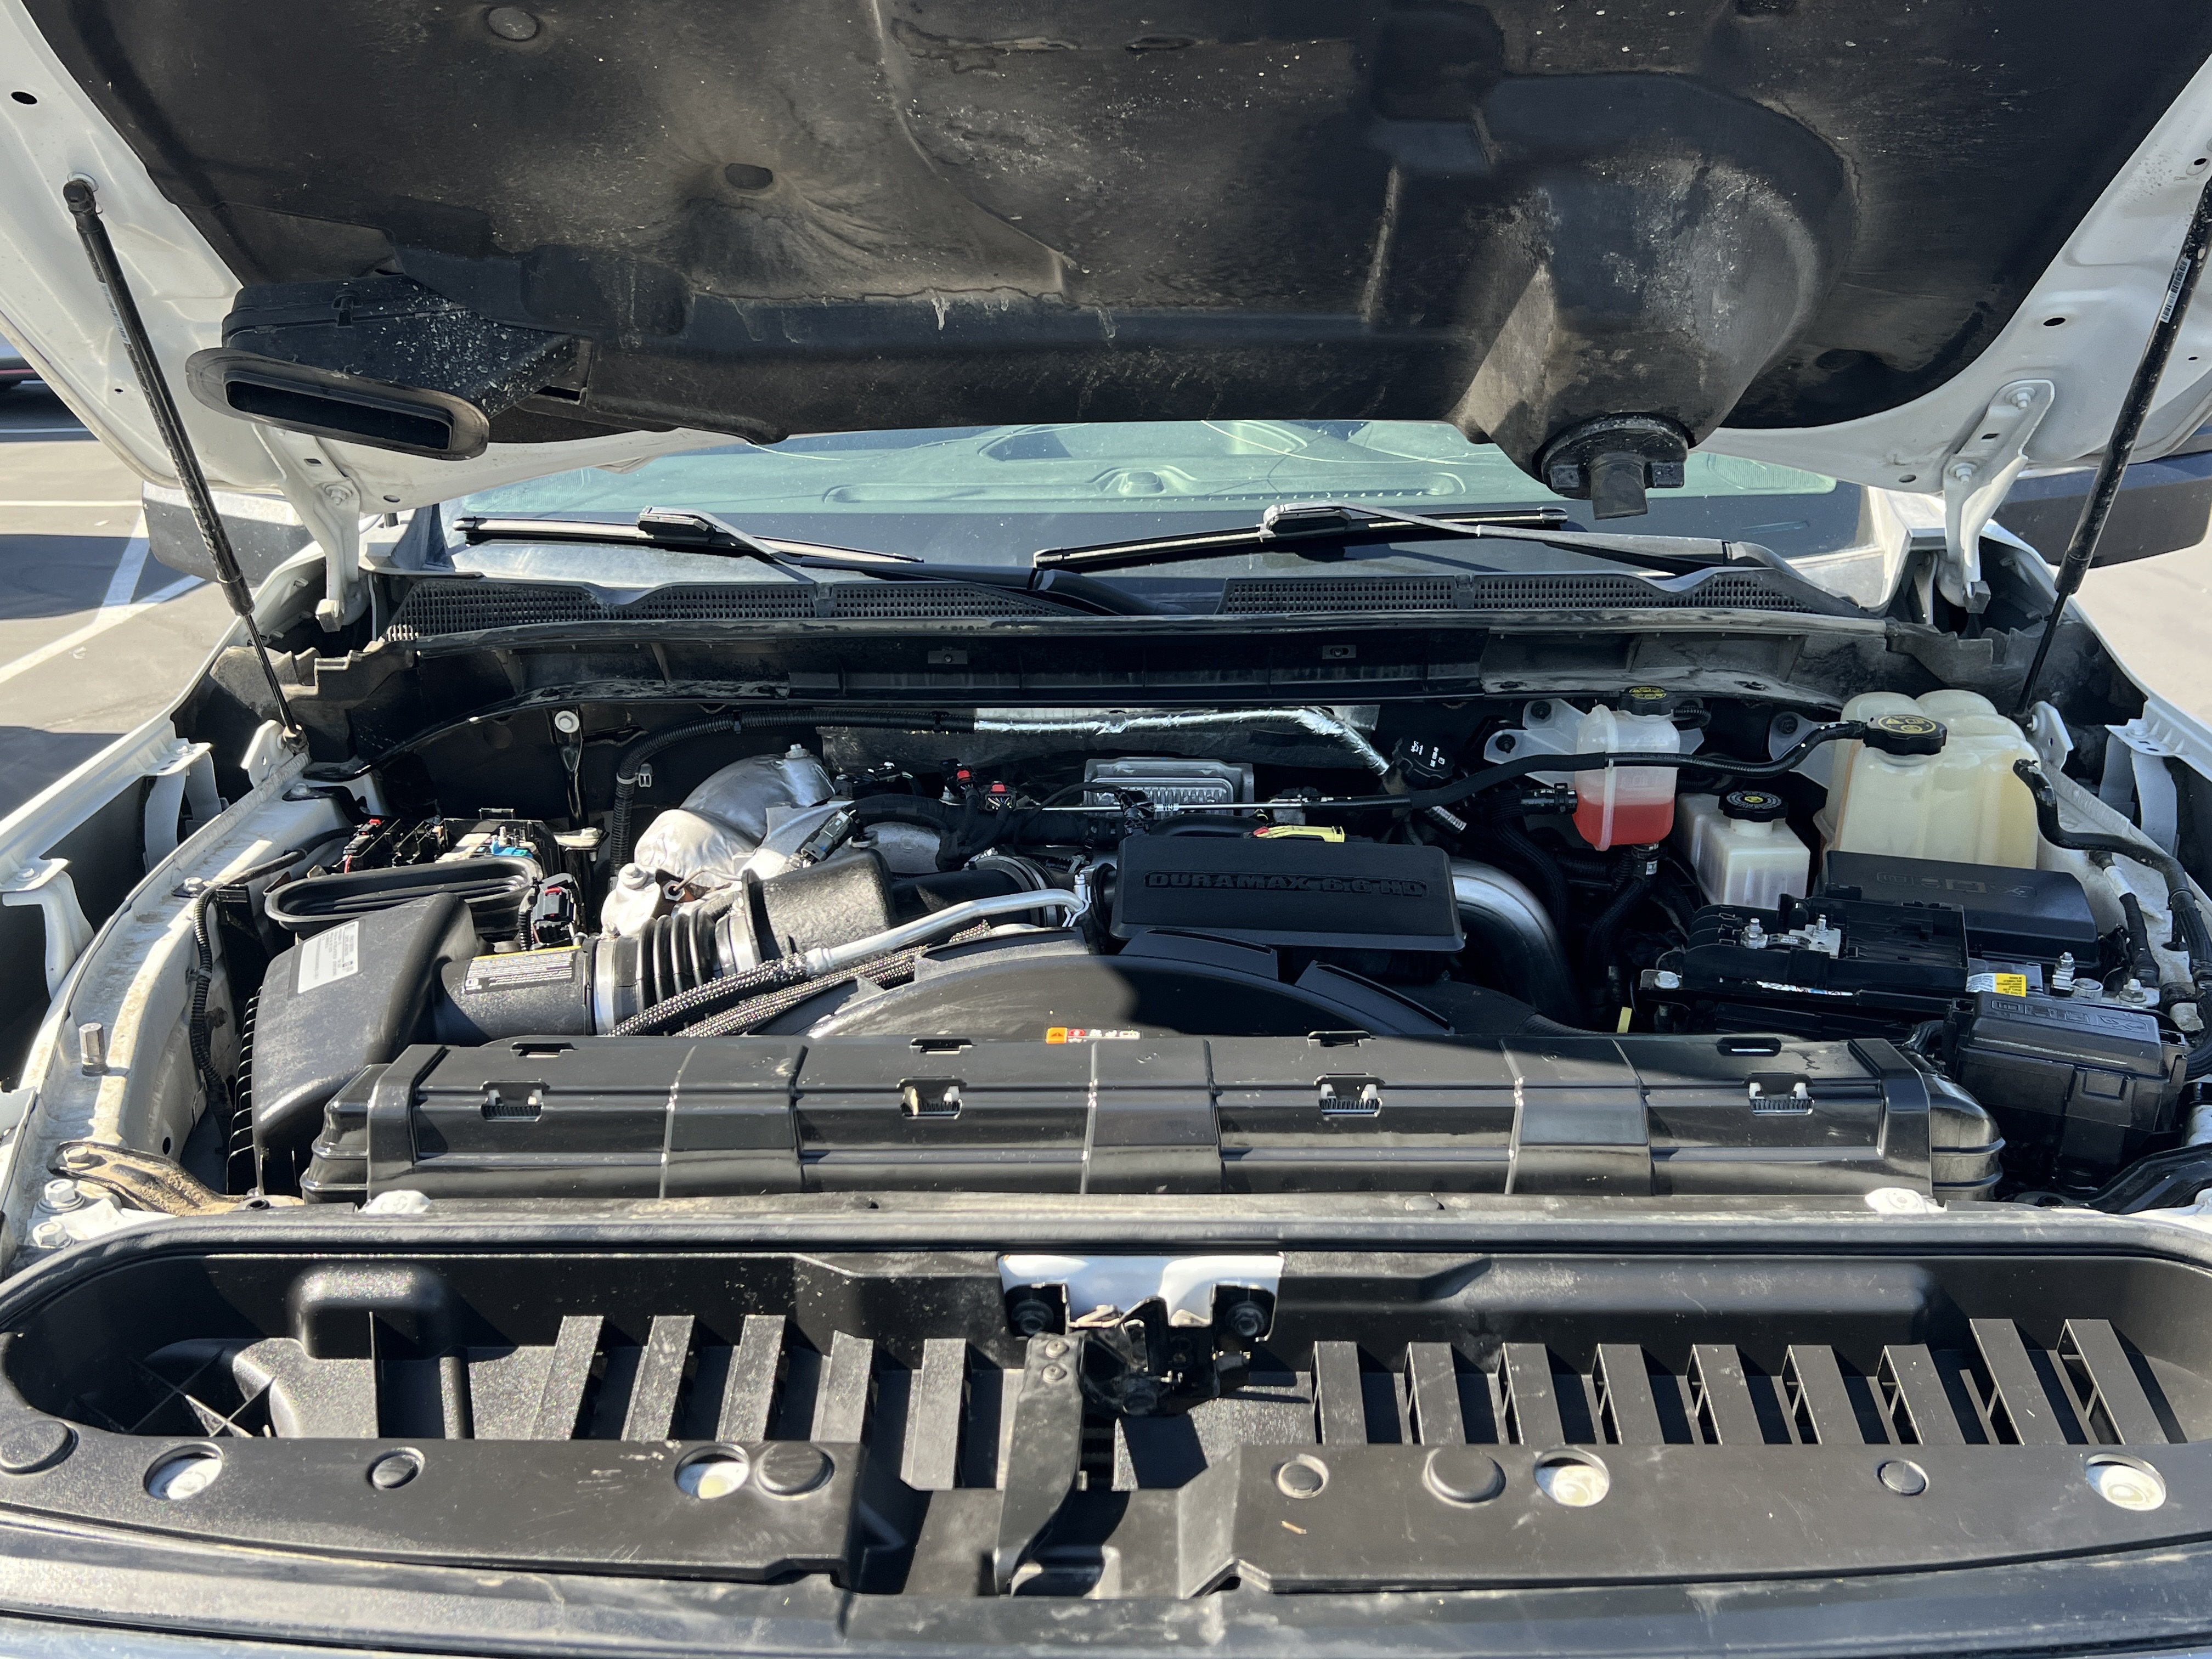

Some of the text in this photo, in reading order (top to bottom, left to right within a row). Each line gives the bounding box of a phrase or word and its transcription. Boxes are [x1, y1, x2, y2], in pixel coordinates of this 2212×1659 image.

[1149, 873, 1424, 897] DURAMAX 6.6 HD
